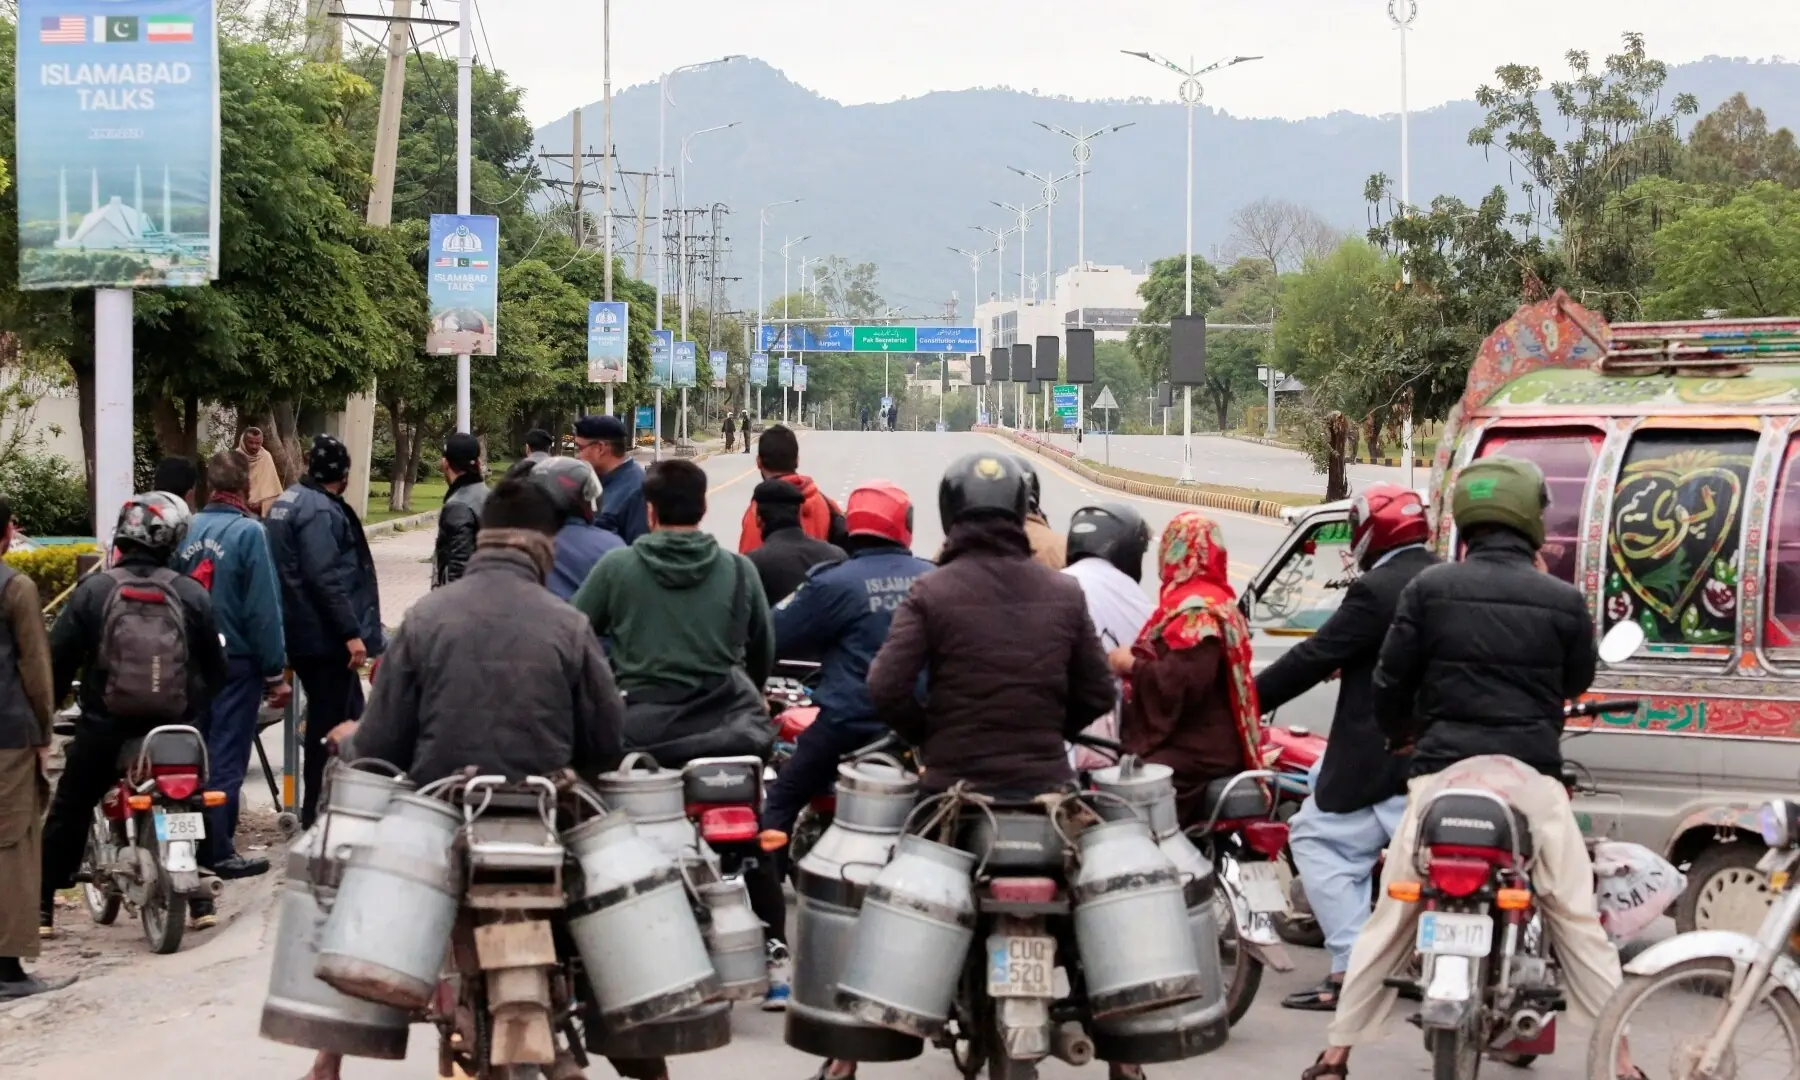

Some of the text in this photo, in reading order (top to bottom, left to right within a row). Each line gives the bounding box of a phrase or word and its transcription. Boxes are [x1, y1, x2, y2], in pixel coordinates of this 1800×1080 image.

[41, 62, 191, 85] ISLAMABAD
[76, 88, 155, 110] TALKS
[435, 273, 488, 283] ISLAMABAD
[447, 282, 475, 292] TALKS
[1440, 817, 1496, 830] HONDA
[1010, 963, 1044, 983] 520
